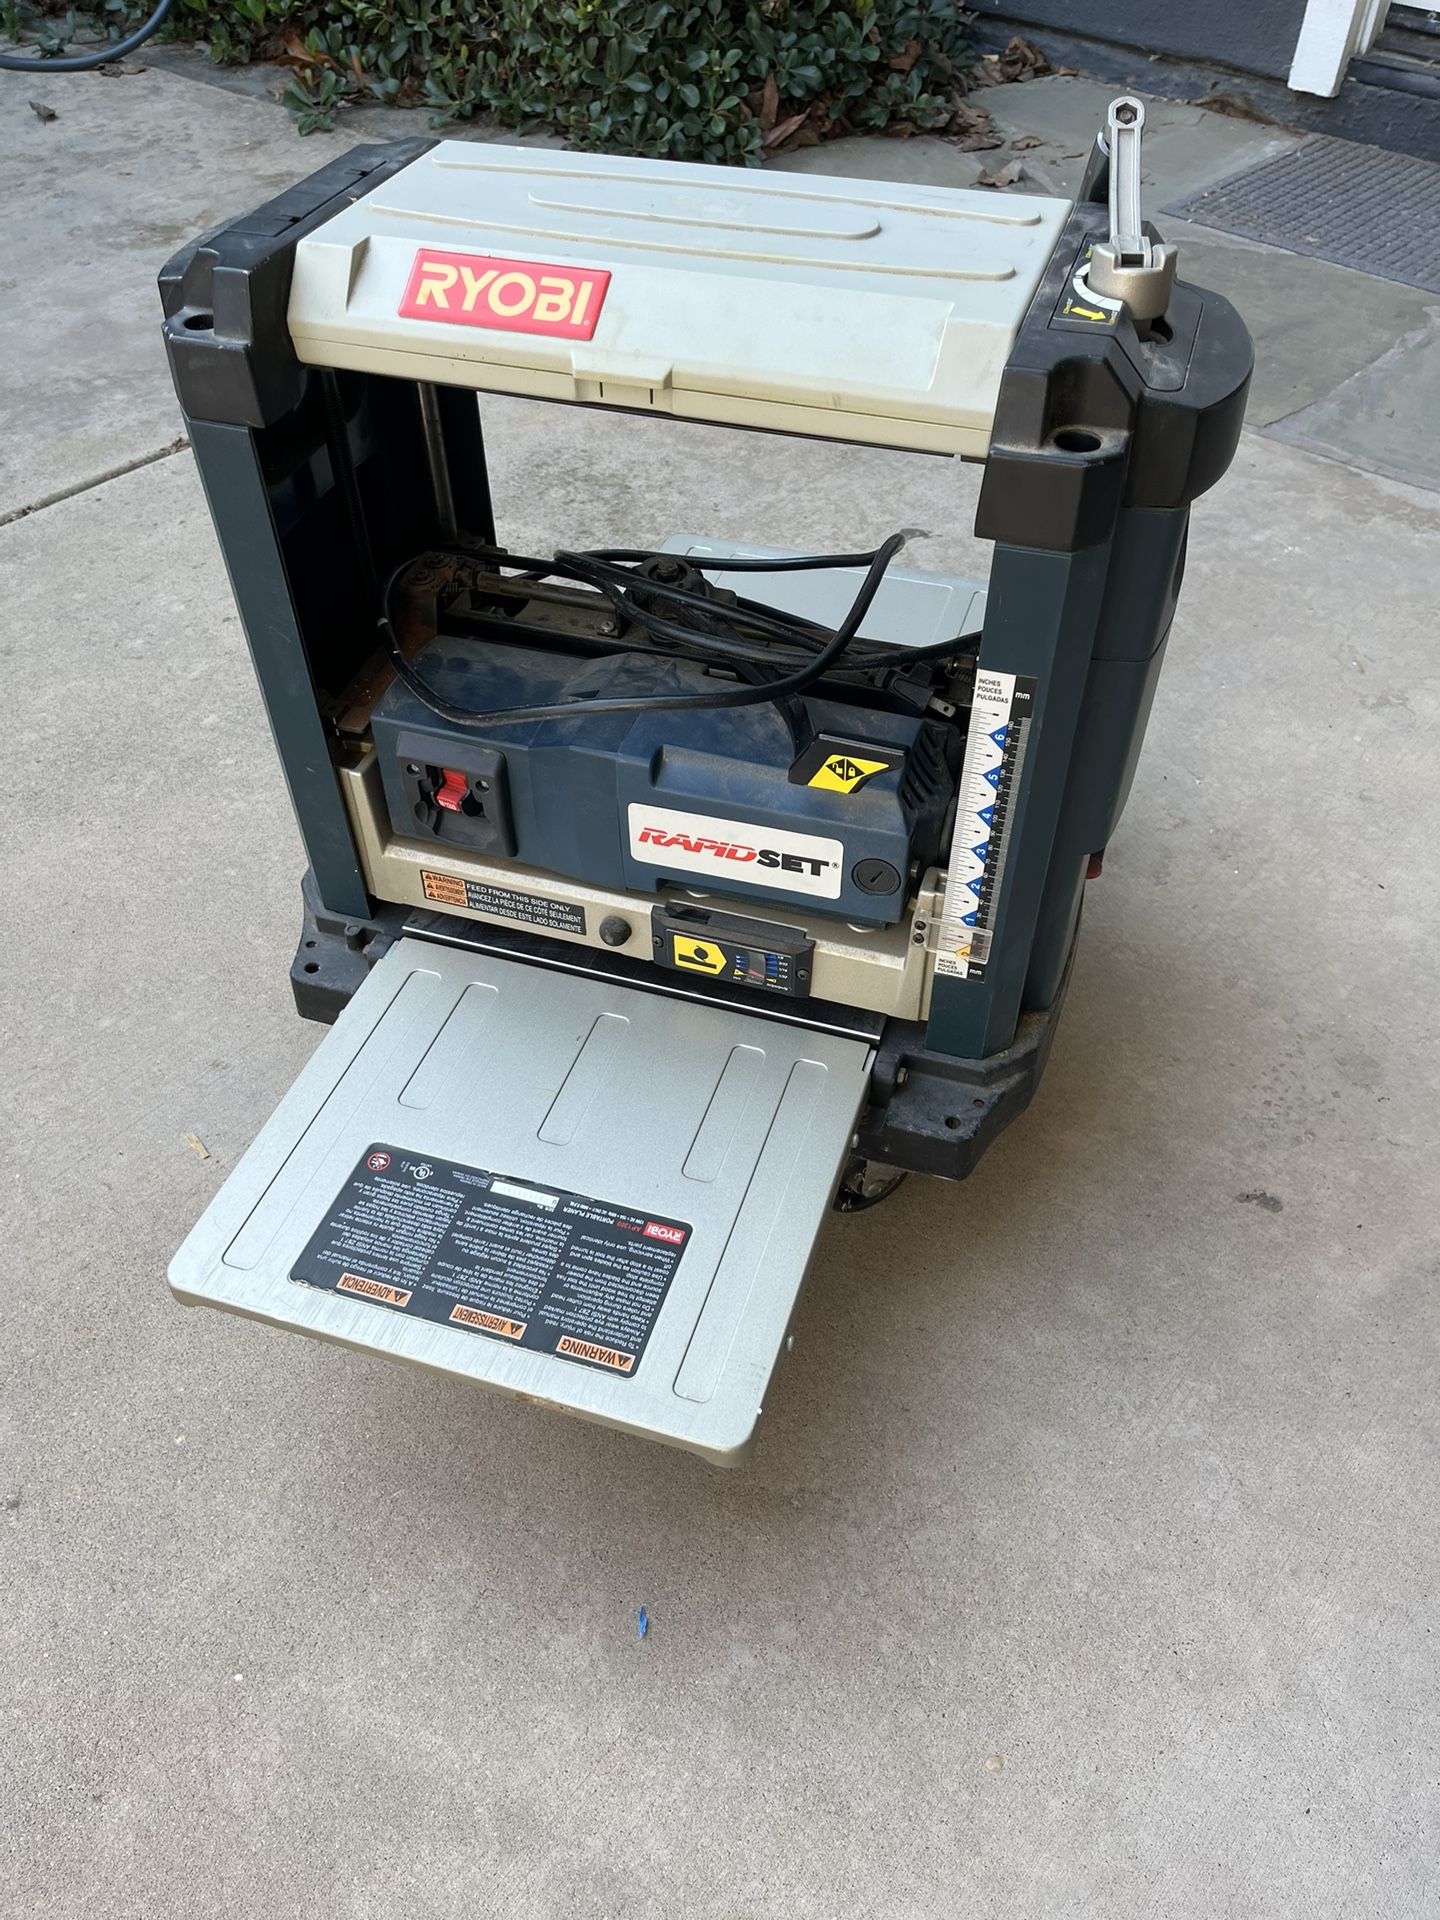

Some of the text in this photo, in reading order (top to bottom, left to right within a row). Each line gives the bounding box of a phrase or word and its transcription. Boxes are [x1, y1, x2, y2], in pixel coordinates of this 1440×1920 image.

[415, 261, 594, 326] RYOBI
[978, 678, 1001, 687] INCHES
[977, 686, 1002, 694] POUCES
[976, 693, 1009, 704] PULGADAS
[1015, 692, 1030, 700] mm
[432, 874, 464, 887] WARNING
[467, 884, 487, 893] FEED
[488, 888, 510, 898] FROM
[512, 893, 530, 902] THIS
[530, 897, 548, 907] SIDE
[468, 892, 492, 902] AVANCEZ
[549, 910, 582, 923] SEULEMENT
[469, 901, 582, 932] ALIMENTAR DESDE ESTE LADO SOLAMENTE
[937, 967, 963, 976] PULGADAS
[562, 1206, 585, 1217] PLANER
[585, 1212, 615, 1224] PORTABLE
[646, 1225, 682, 1241] RYOBI
[580, 1235, 603, 1244] identical
[603, 1240, 616, 1248] only
[642, 1244, 677, 1257] replacement
[581, 1253, 593, 1261] spin
[593, 1258, 612, 1266] blades
[653, 1255, 670, 1263] When
[566, 1269, 584, 1278] power
[602, 1273, 621, 1282] blades
[630, 1268, 651, 1277] caution
[639, 1275, 665, 1287] complete
[340, 1276, 393, 1299] ADVERTENCIA
[570, 1283, 604, 1297] adjustments
[600, 1286, 616, 1294] wood
[607, 1281, 644, 1295] disconnected
[643, 1284, 662, 1292] source
[550, 1293, 566, 1301] head
[635, 1294, 657, 1305] attempt
[644, 1291, 660, 1299] been
[566, 1297, 582, 1305] cutter
[603, 1299, 622, 1309] during
[615, 1297, 631, 1305] make
[543, 1304, 565, 1314] marked
[596, 1304, 612, 1313] away
[622, 1306, 640, 1314] rollers
[565, 1310, 594, 1322] protection
[591, 1311, 606, 1319] ANSI
[612, 1310, 630, 1318] hands
[630, 1314, 646, 1323] Keep
[453, 1308, 508, 1331] AVERTISSEMENT
[619, 1318, 641, 1328] comply
[597, 1327, 630, 1339] understand
[620, 1325, 641, 1336] Always
[604, 1336, 627, 1346] Reduce
[560, 1339, 617, 1364] WARNING
